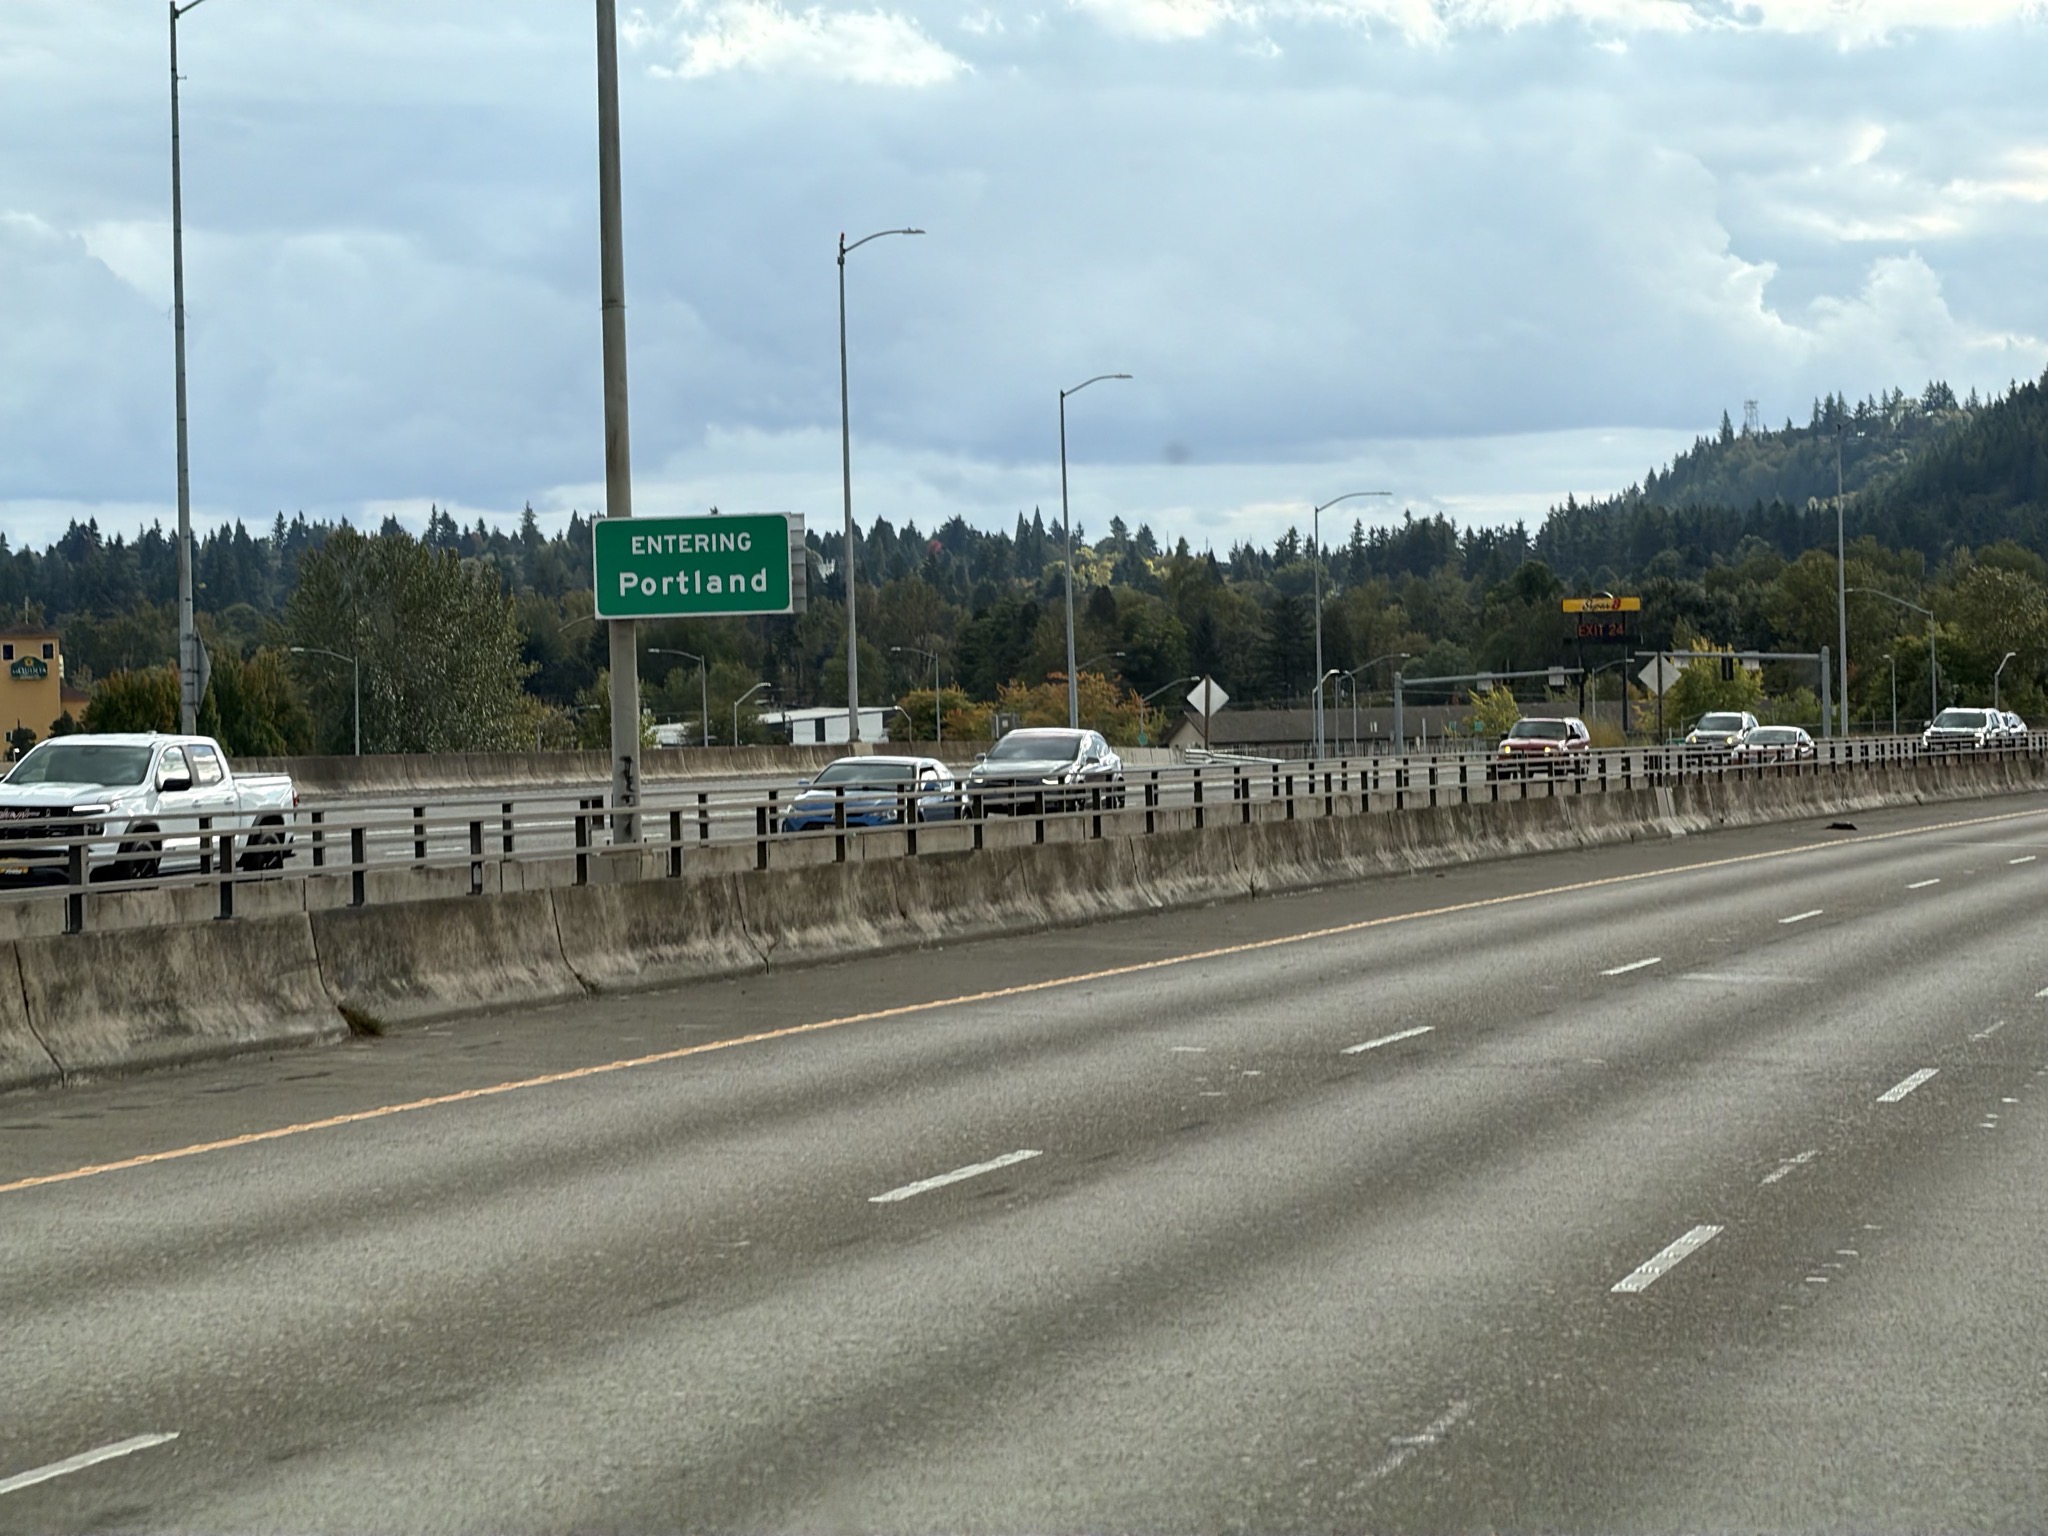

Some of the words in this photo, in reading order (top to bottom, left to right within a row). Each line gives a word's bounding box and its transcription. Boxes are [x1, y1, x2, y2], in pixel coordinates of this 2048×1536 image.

[632, 532, 752, 555] ENTERING
[619, 567, 767, 597] Portland
[1578, 624, 1603, 637] EXIT
[1608, 623, 1624, 636] 24
